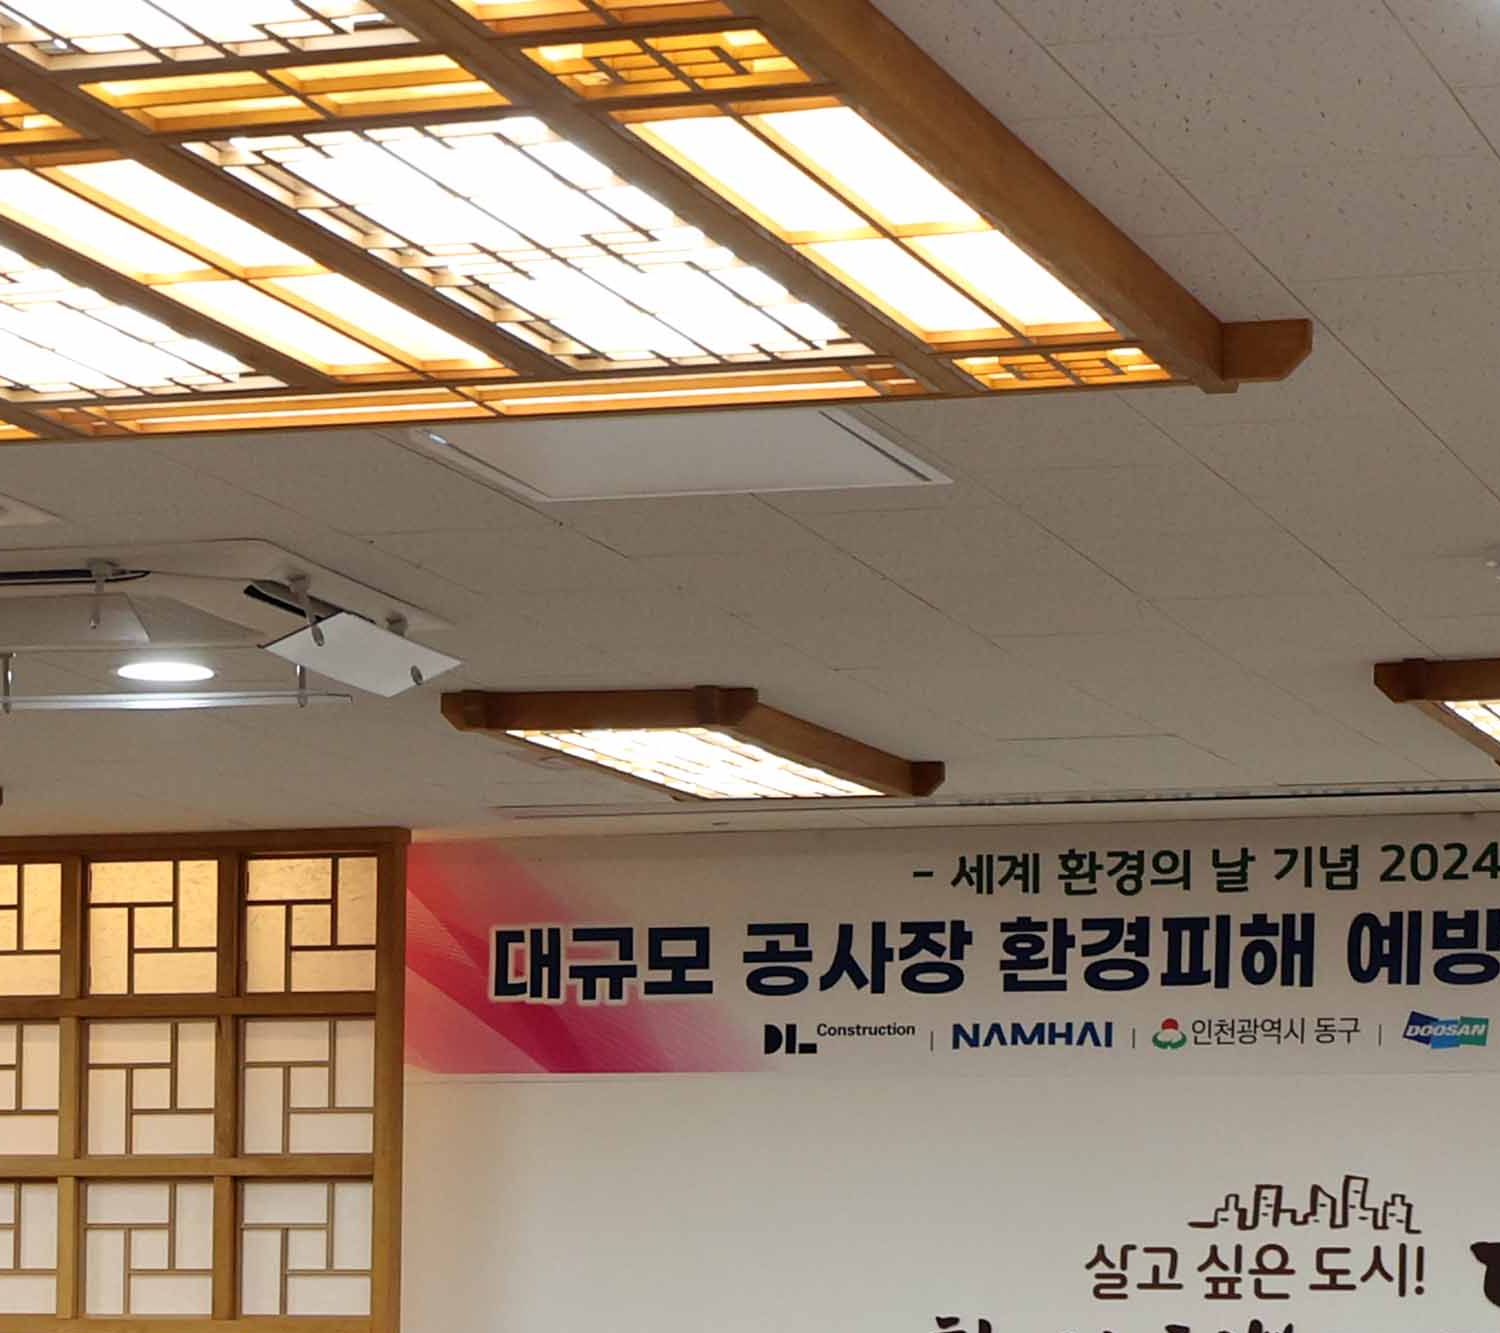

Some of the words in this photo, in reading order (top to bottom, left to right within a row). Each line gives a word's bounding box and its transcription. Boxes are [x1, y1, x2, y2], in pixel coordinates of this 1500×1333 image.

[951, 853, 1039, 894] 세계
[1058, 849, 1190, 896] 환경의
[1212, 848, 1255, 892] 날
[1274, 845, 1358, 890] 기념
[495, 926, 713, 1000] 대규모
[743, 920, 972, 996] 공사장
[1000, 913, 1315, 992] 환경피해
[817, 1024, 915, 1036] Construction
[953, 1022, 1112, 1049] NAMHAI
[1192, 1018, 1304, 1045] 인천광역시
[1315, 1018, 1360, 1043] 동구
[1405, 1023, 1487, 1038] DOOSAN
[1086, 1244, 1183, 1299] 살고
[1198, 1244, 1295, 1299] 싶은
[1309, 1243, 1424, 1297] 도시!
